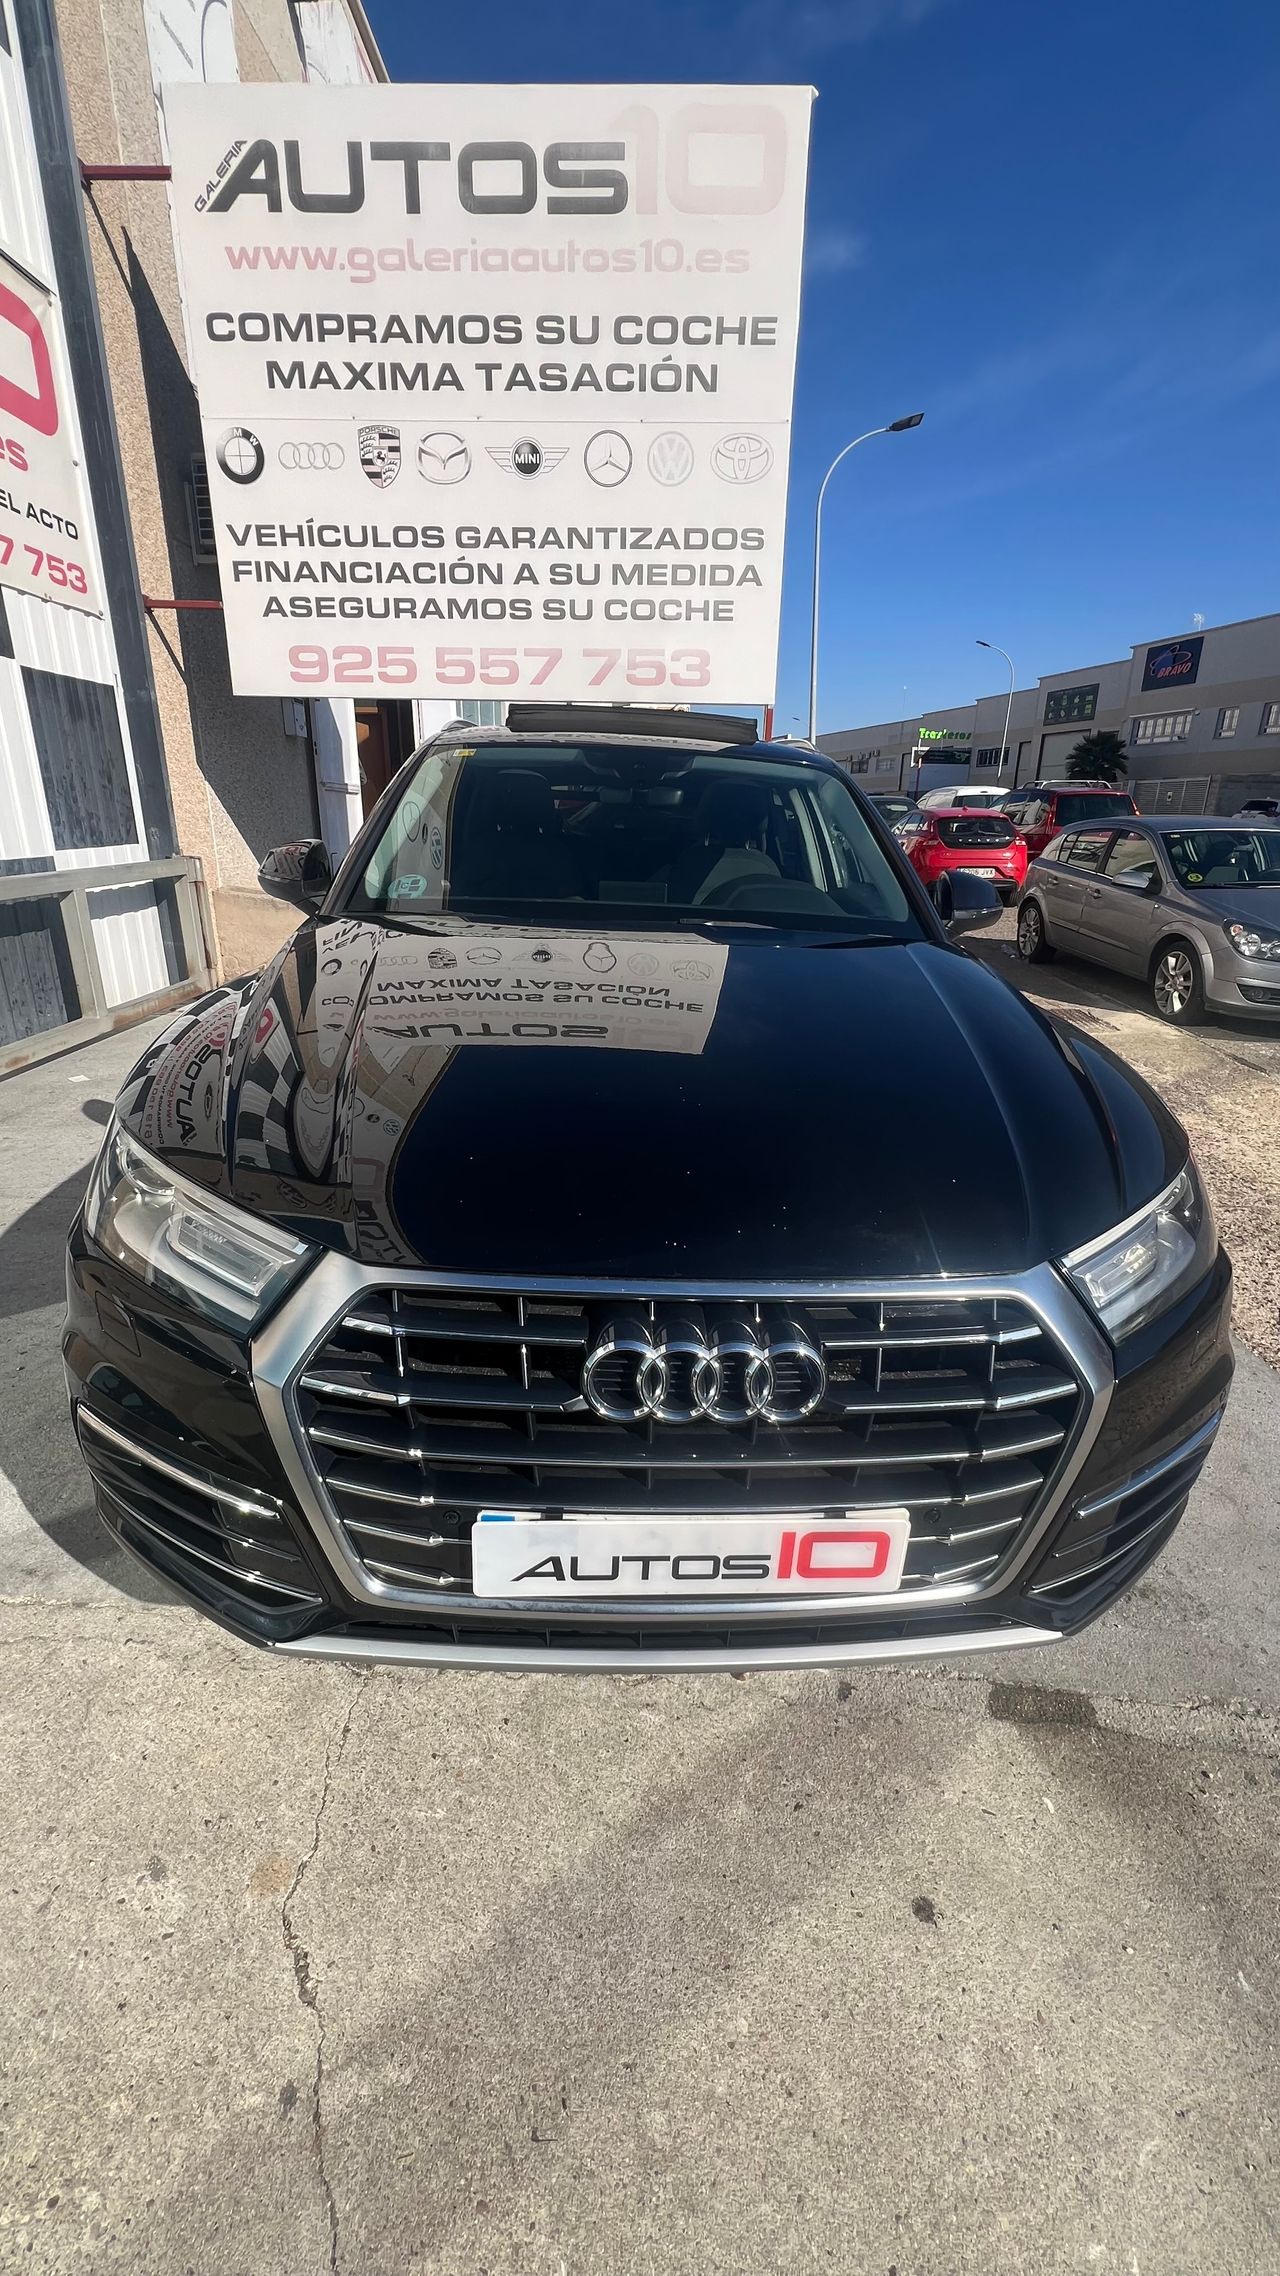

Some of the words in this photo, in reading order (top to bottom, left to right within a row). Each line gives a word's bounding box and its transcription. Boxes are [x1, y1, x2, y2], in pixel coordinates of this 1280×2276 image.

[194, 140, 248, 212] GALERIA
[223, 237, 751, 284] www.galeriaautos10.es
[205, 312, 523, 345] COMPRAMOS
[535, 314, 600, 345] SU
[613, 315, 779, 347] COCHE
[265, 359, 465, 393] MAXIMA
[475, 353, 720, 394] TASACIÓN
[514, 453, 540, 464] MINI
[26, 506, 79, 540] ACTO
[226, 518, 445, 550] VEHÍCULOS
[455, 525, 765, 553] GARANTIZADOS
[23, 543, 87, 594] 753
[233, 556, 503, 586] FINANCIACIÓN
[513, 564, 540, 586] A
[548, 563, 600, 587] SU
[612, 564, 763, 588] MEDIDA
[262, 597, 532, 621] ASEGURAMOS
[543, 598, 593, 622] SU
[604, 599, 734, 623] COCHE
[288, 645, 417, 685] 925
[435, 647, 563, 687] 557
[582, 649, 711, 689] 753
[1157, 662, 1192, 679] BRAVO
[510, 1531, 891, 1582] AUTOS10
